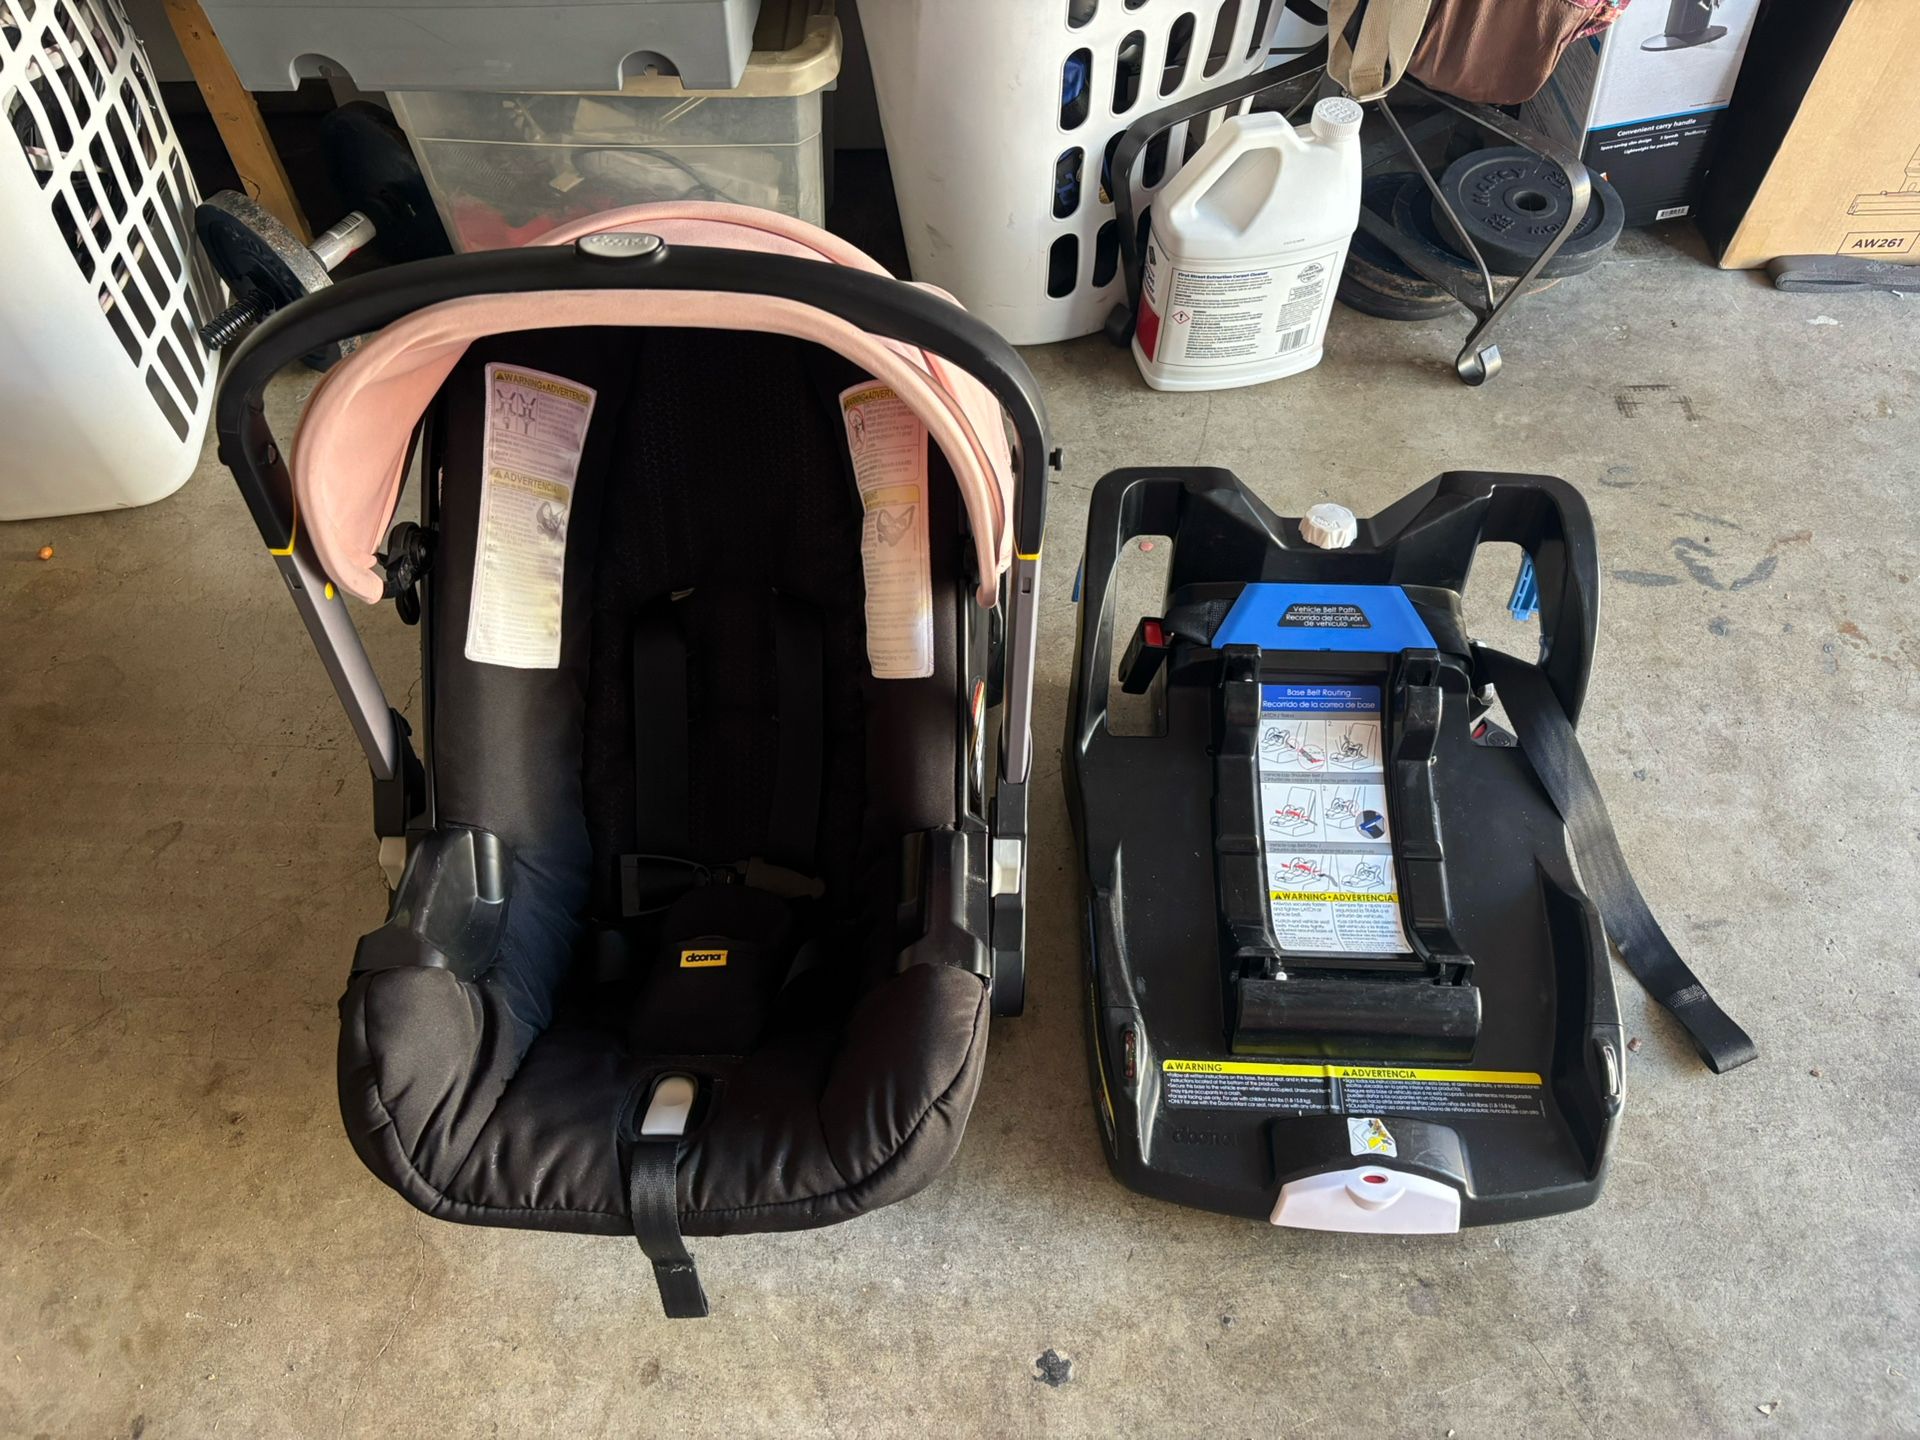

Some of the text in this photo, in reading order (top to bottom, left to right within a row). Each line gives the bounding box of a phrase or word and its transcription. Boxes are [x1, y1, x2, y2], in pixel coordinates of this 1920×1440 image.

[1617, 119, 1696, 137] Convenient carry handle
[1624, 146, 1649, 154] Lightweight
[1656, 141, 1679, 149] portability
[1851, 238, 1904, 248] AW261
[1286, 613, 1320, 621] Recorrido
[1322, 689, 1352, 697] Routing
[1262, 700, 1298, 708] Recorrido
[1357, 701, 1376, 709] base
[1282, 892, 1393, 902] WARNING ADVERTENCIA
[686, 952, 721, 962] doona
[1175, 1063, 1222, 1072] WARNING
[1351, 1069, 1416, 1079] ADVERTENCIA
